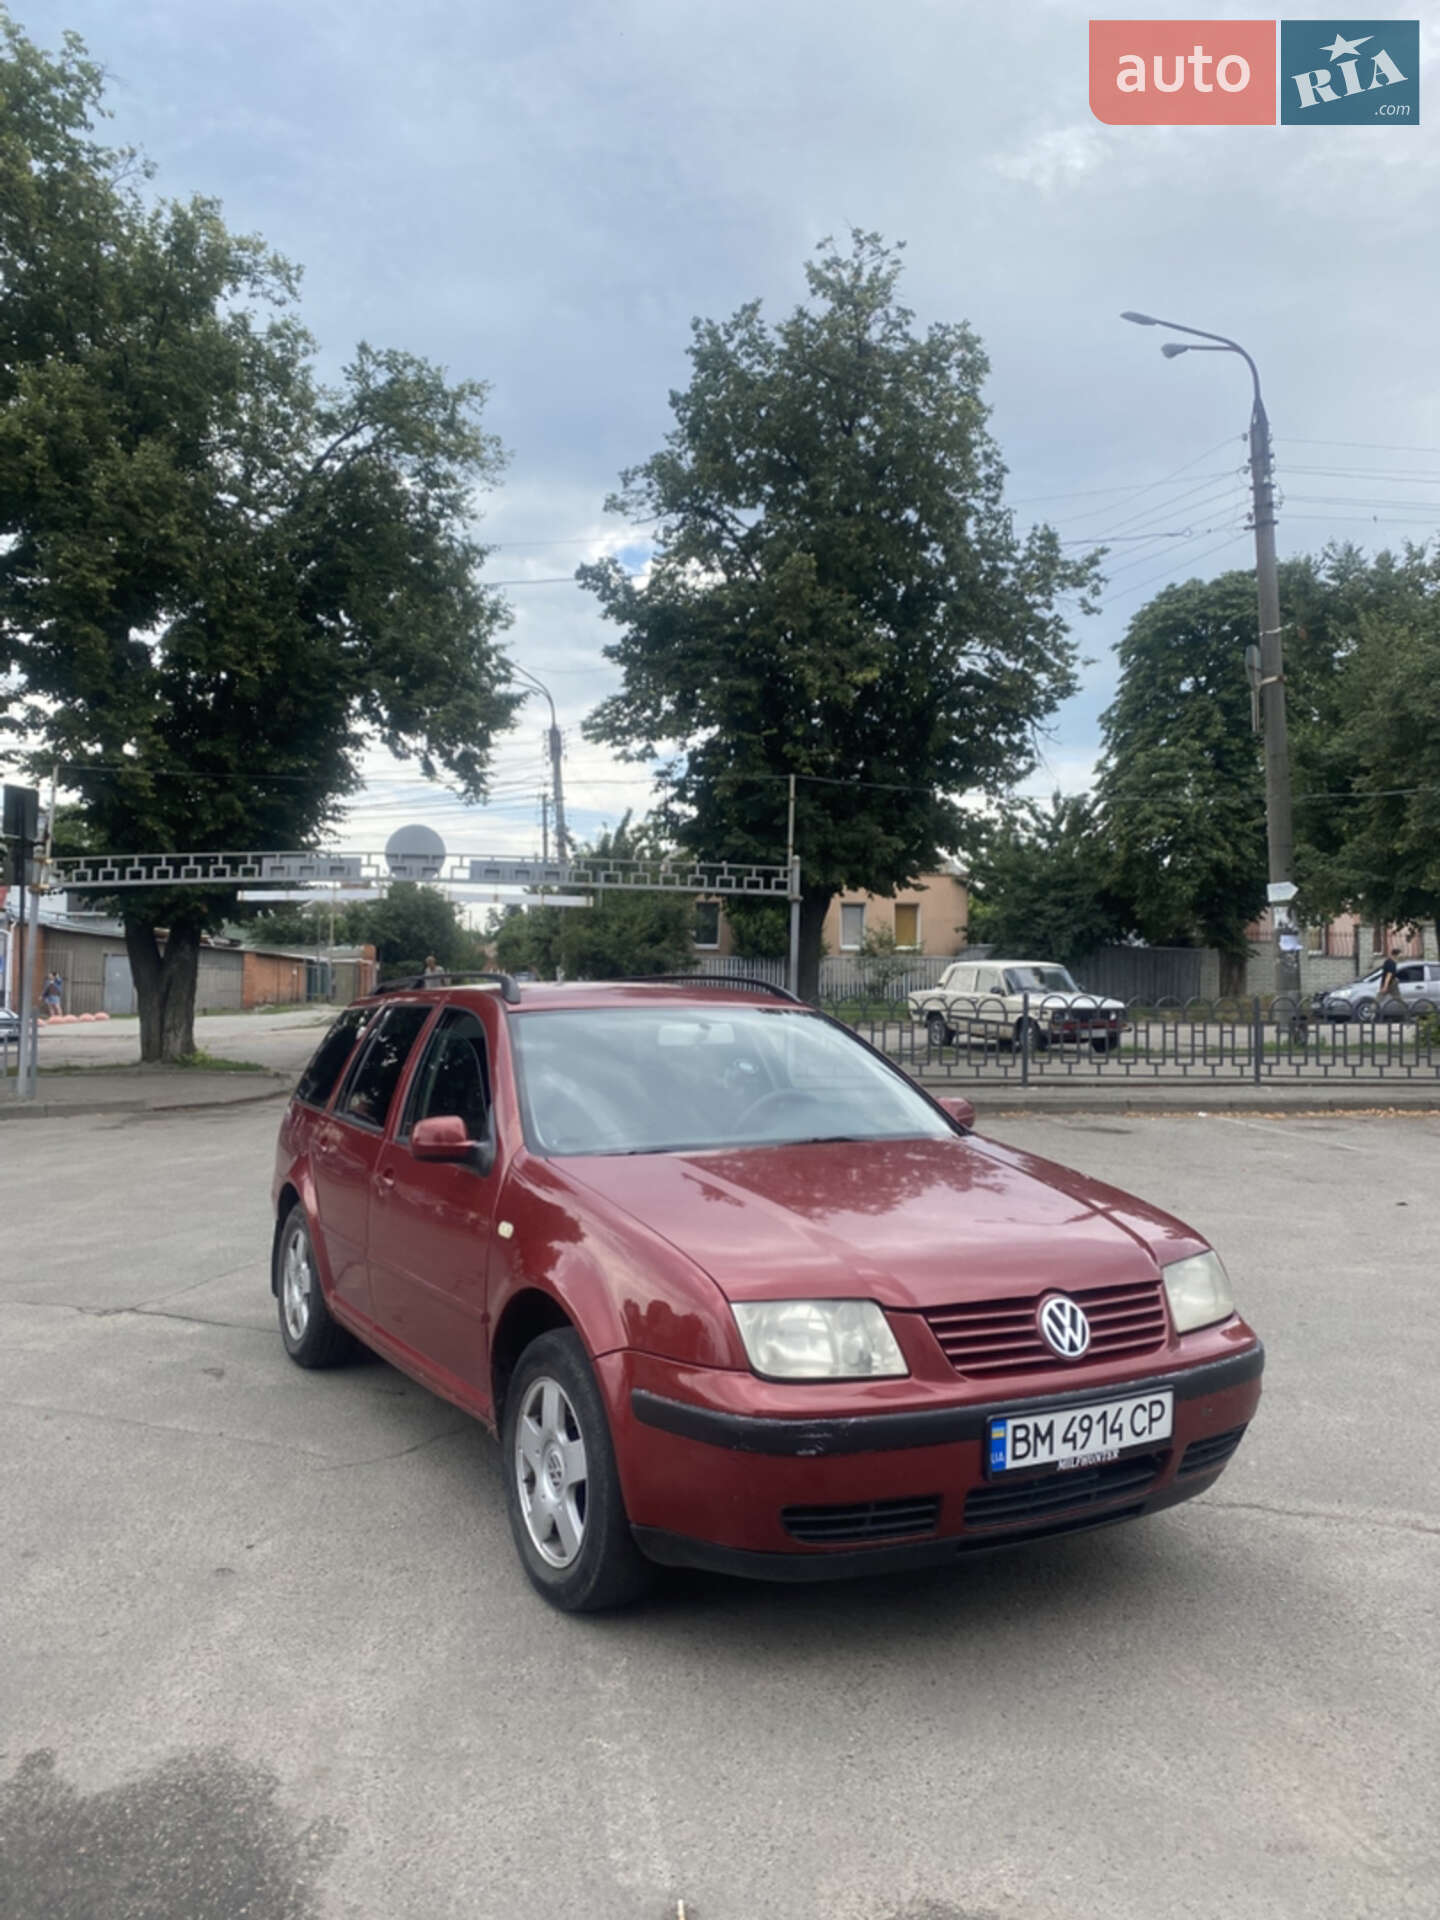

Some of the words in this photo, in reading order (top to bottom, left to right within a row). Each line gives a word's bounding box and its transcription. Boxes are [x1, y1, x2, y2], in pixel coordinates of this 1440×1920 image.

[1012, 1419, 1054, 1461] BM
[1062, 1407, 1123, 1451] 4914
[1130, 1400, 1166, 1437] CP
